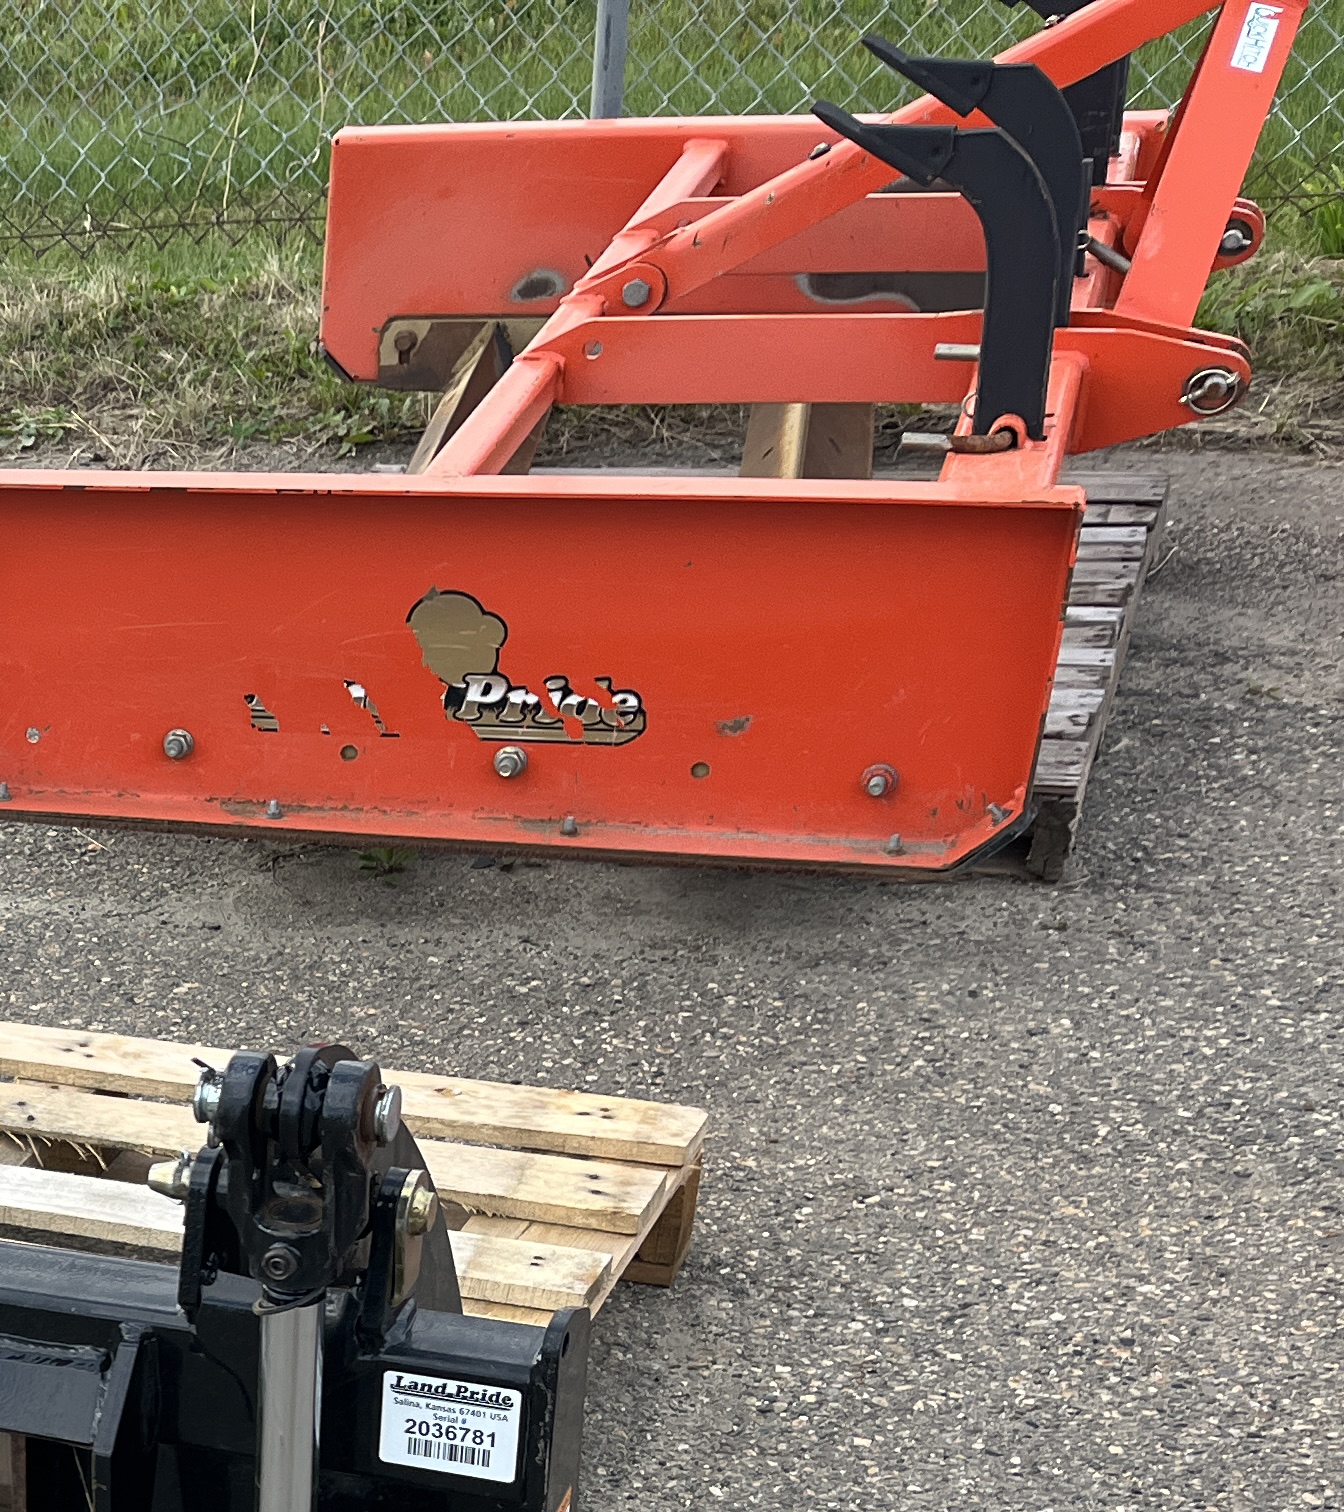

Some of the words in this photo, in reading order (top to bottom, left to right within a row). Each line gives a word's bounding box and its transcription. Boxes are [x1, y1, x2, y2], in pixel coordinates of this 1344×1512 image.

[390, 1374, 449, 1399] Land
[453, 1383, 514, 1408] Pride
[393, 1396, 423, 1410] Salina,
[424, 1401, 457, 1414] Kansas
[458, 1407, 487, 1419] 67401
[489, 1412, 509, 1423] USA
[432, 1412, 459, 1424] Serial
[403, 1417, 496, 1448] 2036781
